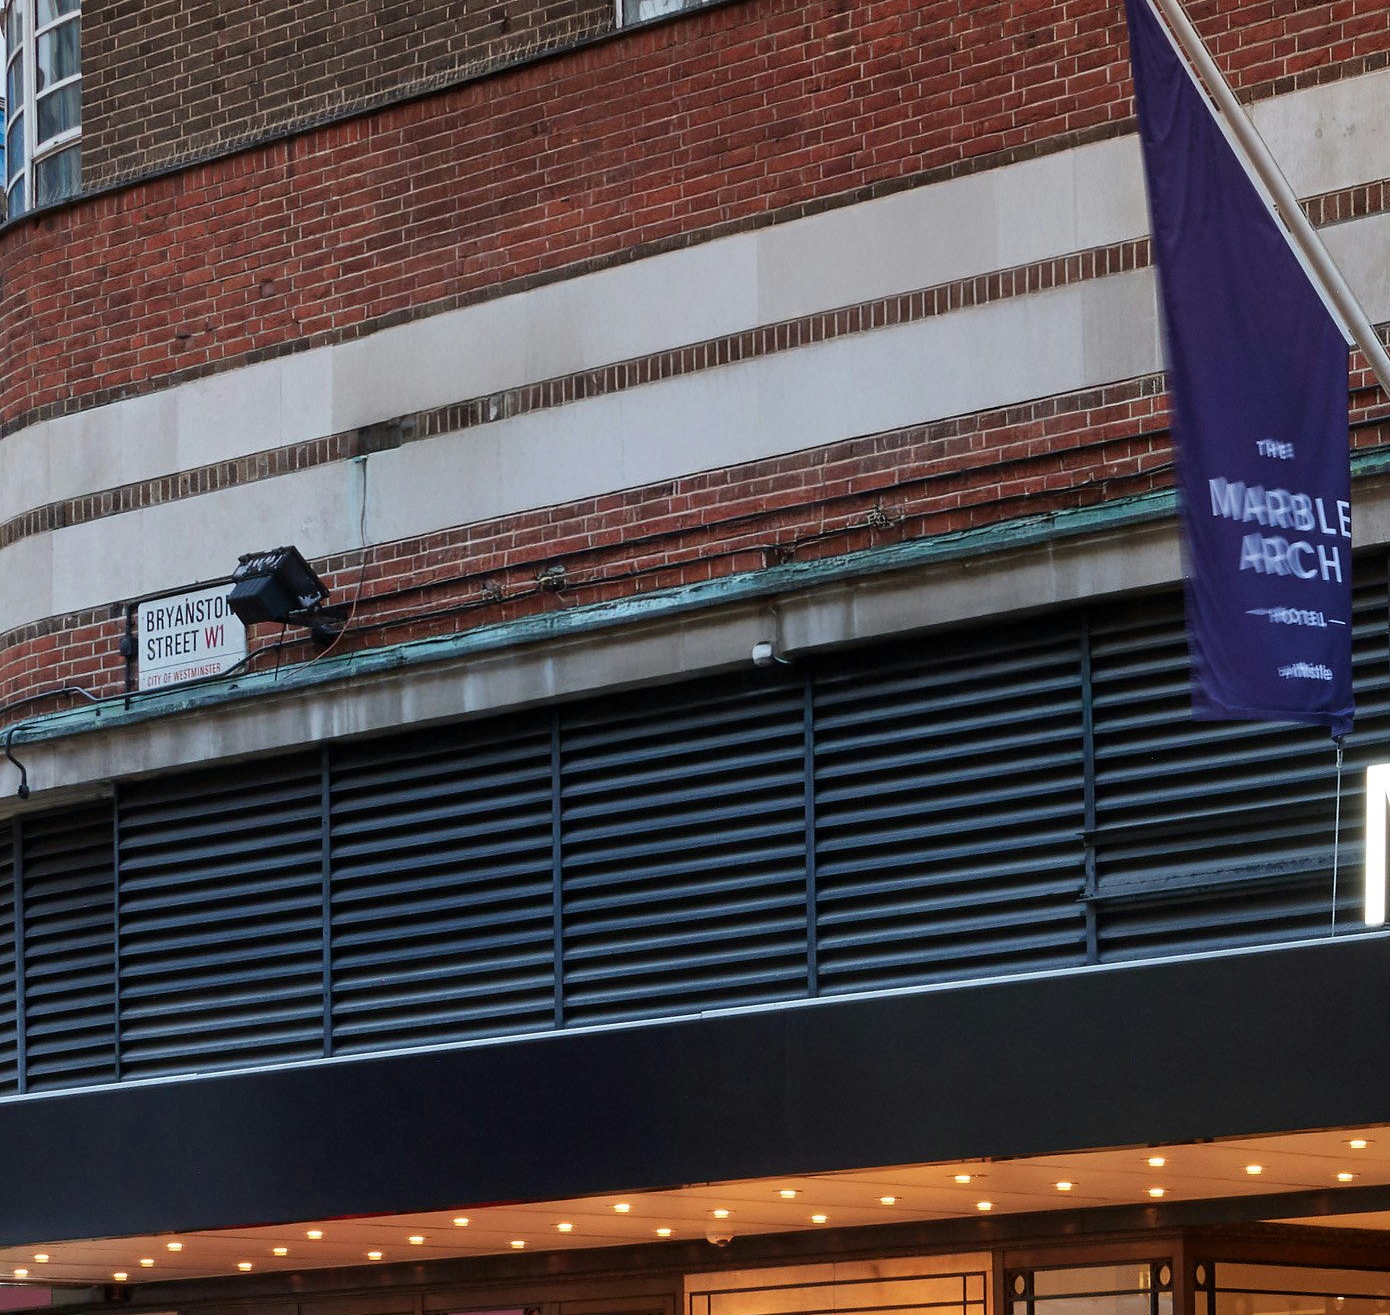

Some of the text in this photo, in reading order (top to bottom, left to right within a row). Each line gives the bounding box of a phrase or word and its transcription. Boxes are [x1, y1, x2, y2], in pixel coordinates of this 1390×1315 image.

[1256, 440, 1295, 460] THE
[1209, 476, 1351, 538] MARBLE
[1239, 533, 1343, 583] ARCH
[147, 624, 224, 661] STREET W1
[147, 662, 221, 687] CITY OF WESTMINSTER
